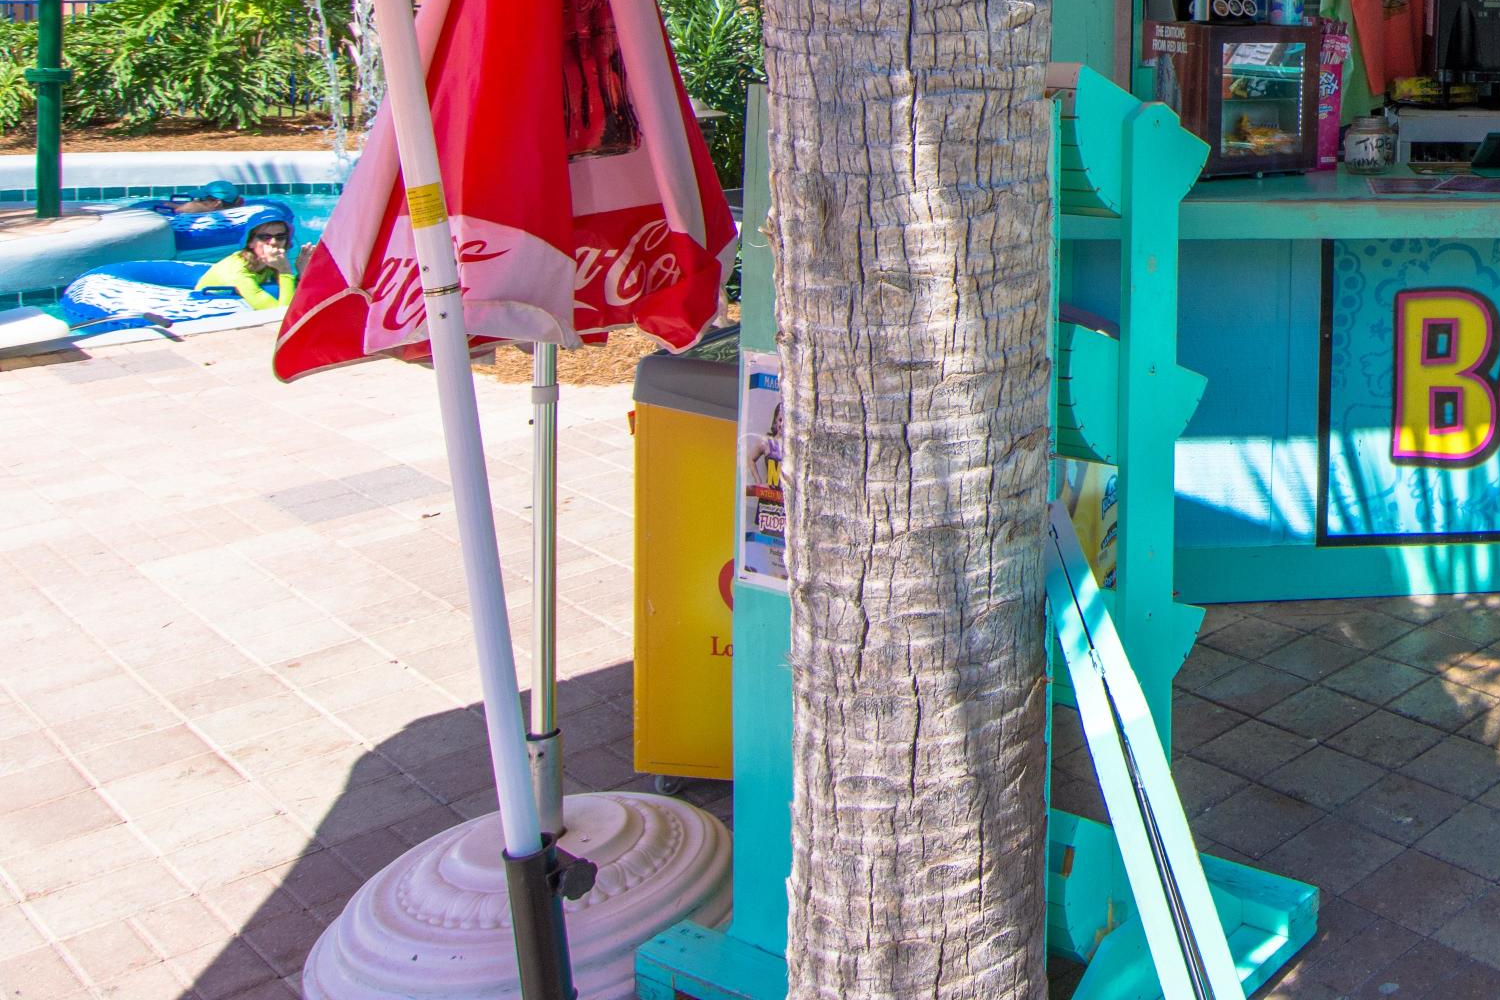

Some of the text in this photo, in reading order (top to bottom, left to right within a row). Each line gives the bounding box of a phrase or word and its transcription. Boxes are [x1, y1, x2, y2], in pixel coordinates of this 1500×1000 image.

[1155, 25, 1186, 39] THE EDITIONS
[1152, 39, 1166, 51] FROM
[1167, 40, 1176, 52] RED
